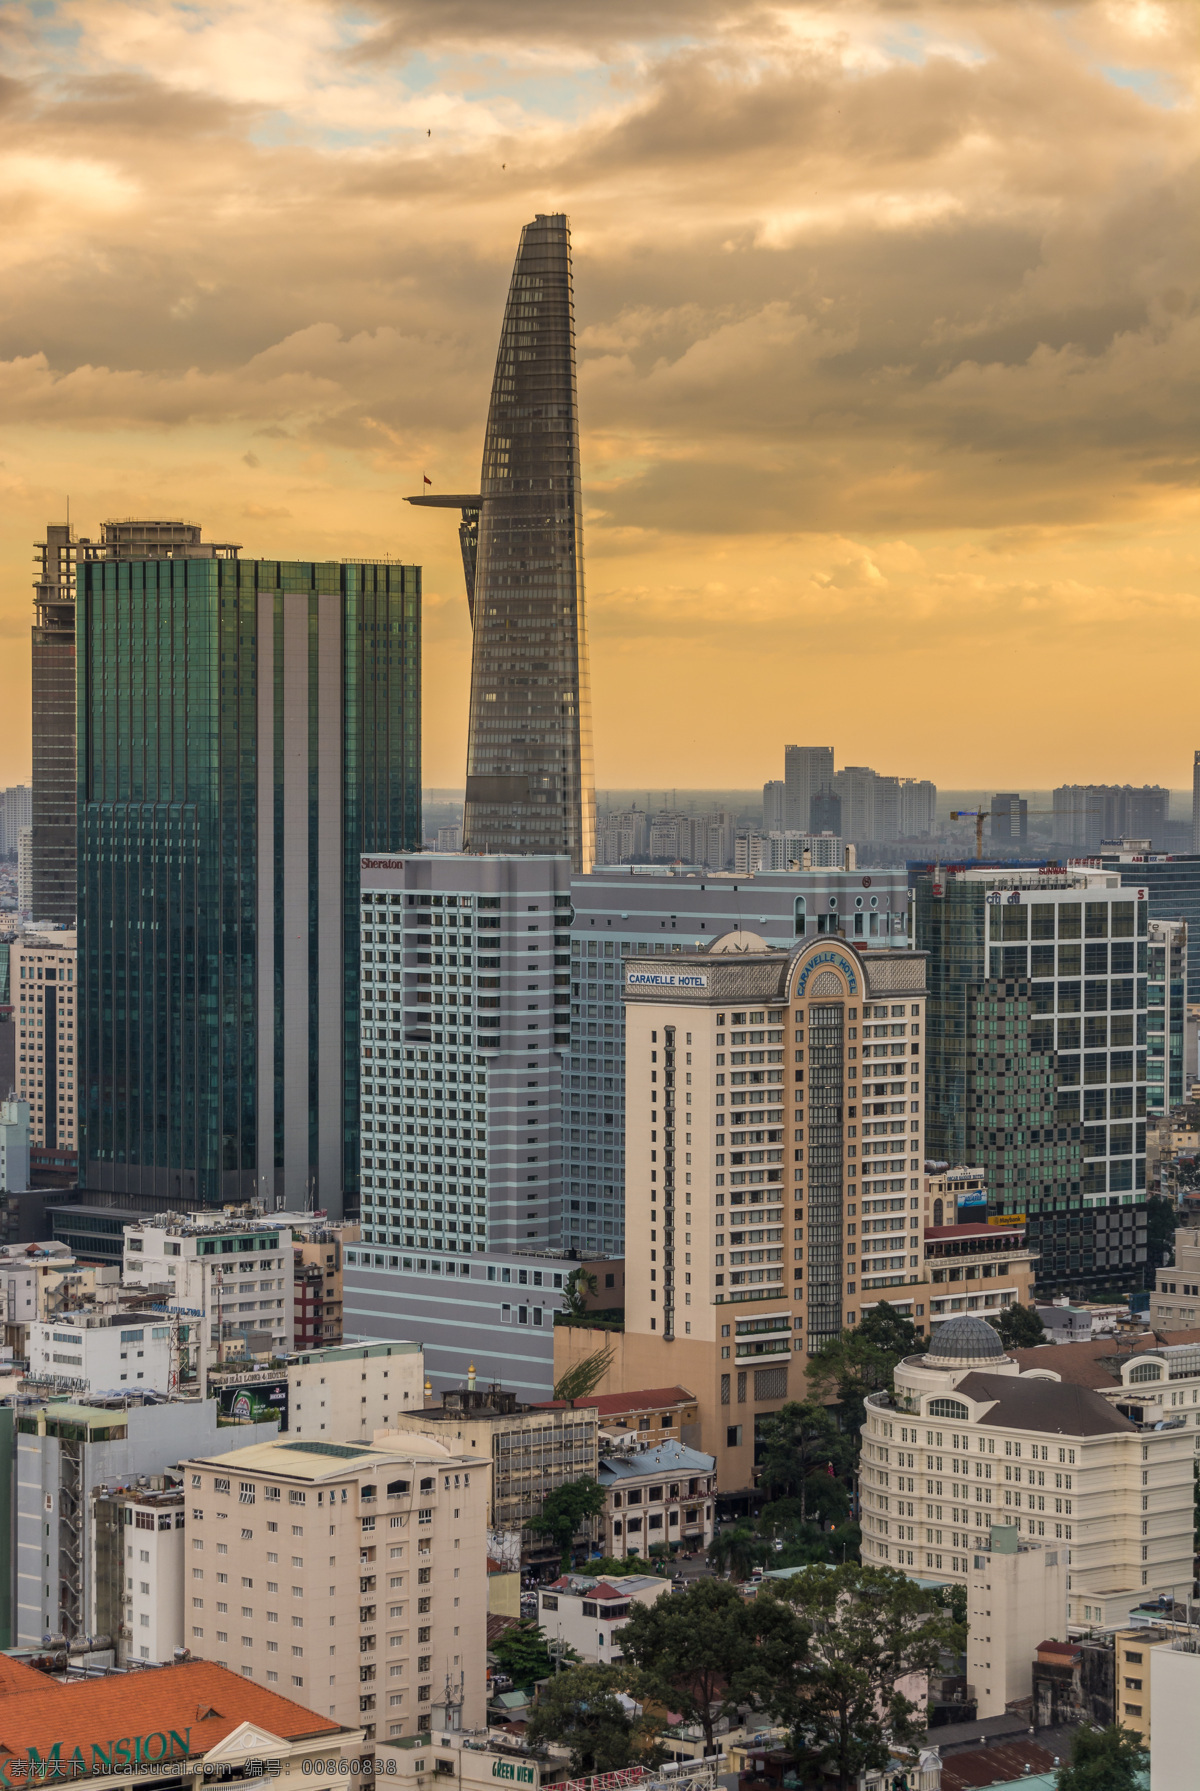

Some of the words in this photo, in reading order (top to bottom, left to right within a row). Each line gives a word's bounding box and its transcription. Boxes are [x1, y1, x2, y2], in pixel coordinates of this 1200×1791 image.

[361, 857, 403, 869] Sheraton
[1039, 867, 1067, 875] SUNWAH
[986, 892, 1001, 904] citi
[1007, 892, 1021, 904] citi
[629, 974, 675, 985] CARAVELLE
[678, 976, 705, 986] HOTEL
[797, 953, 836, 996] CARAVELLE
[839, 958, 856, 994] HOTEL
[1000, 1216, 1021, 1224] Maybank
[244, 1373, 261, 1382] LONG
[267, 1371, 288, 1379] HOTEL
[25, 1727, 192, 1783] MANSION
[492, 1761, 515, 1780] GREEN
[517, 1765, 534, 1784] VIEW
